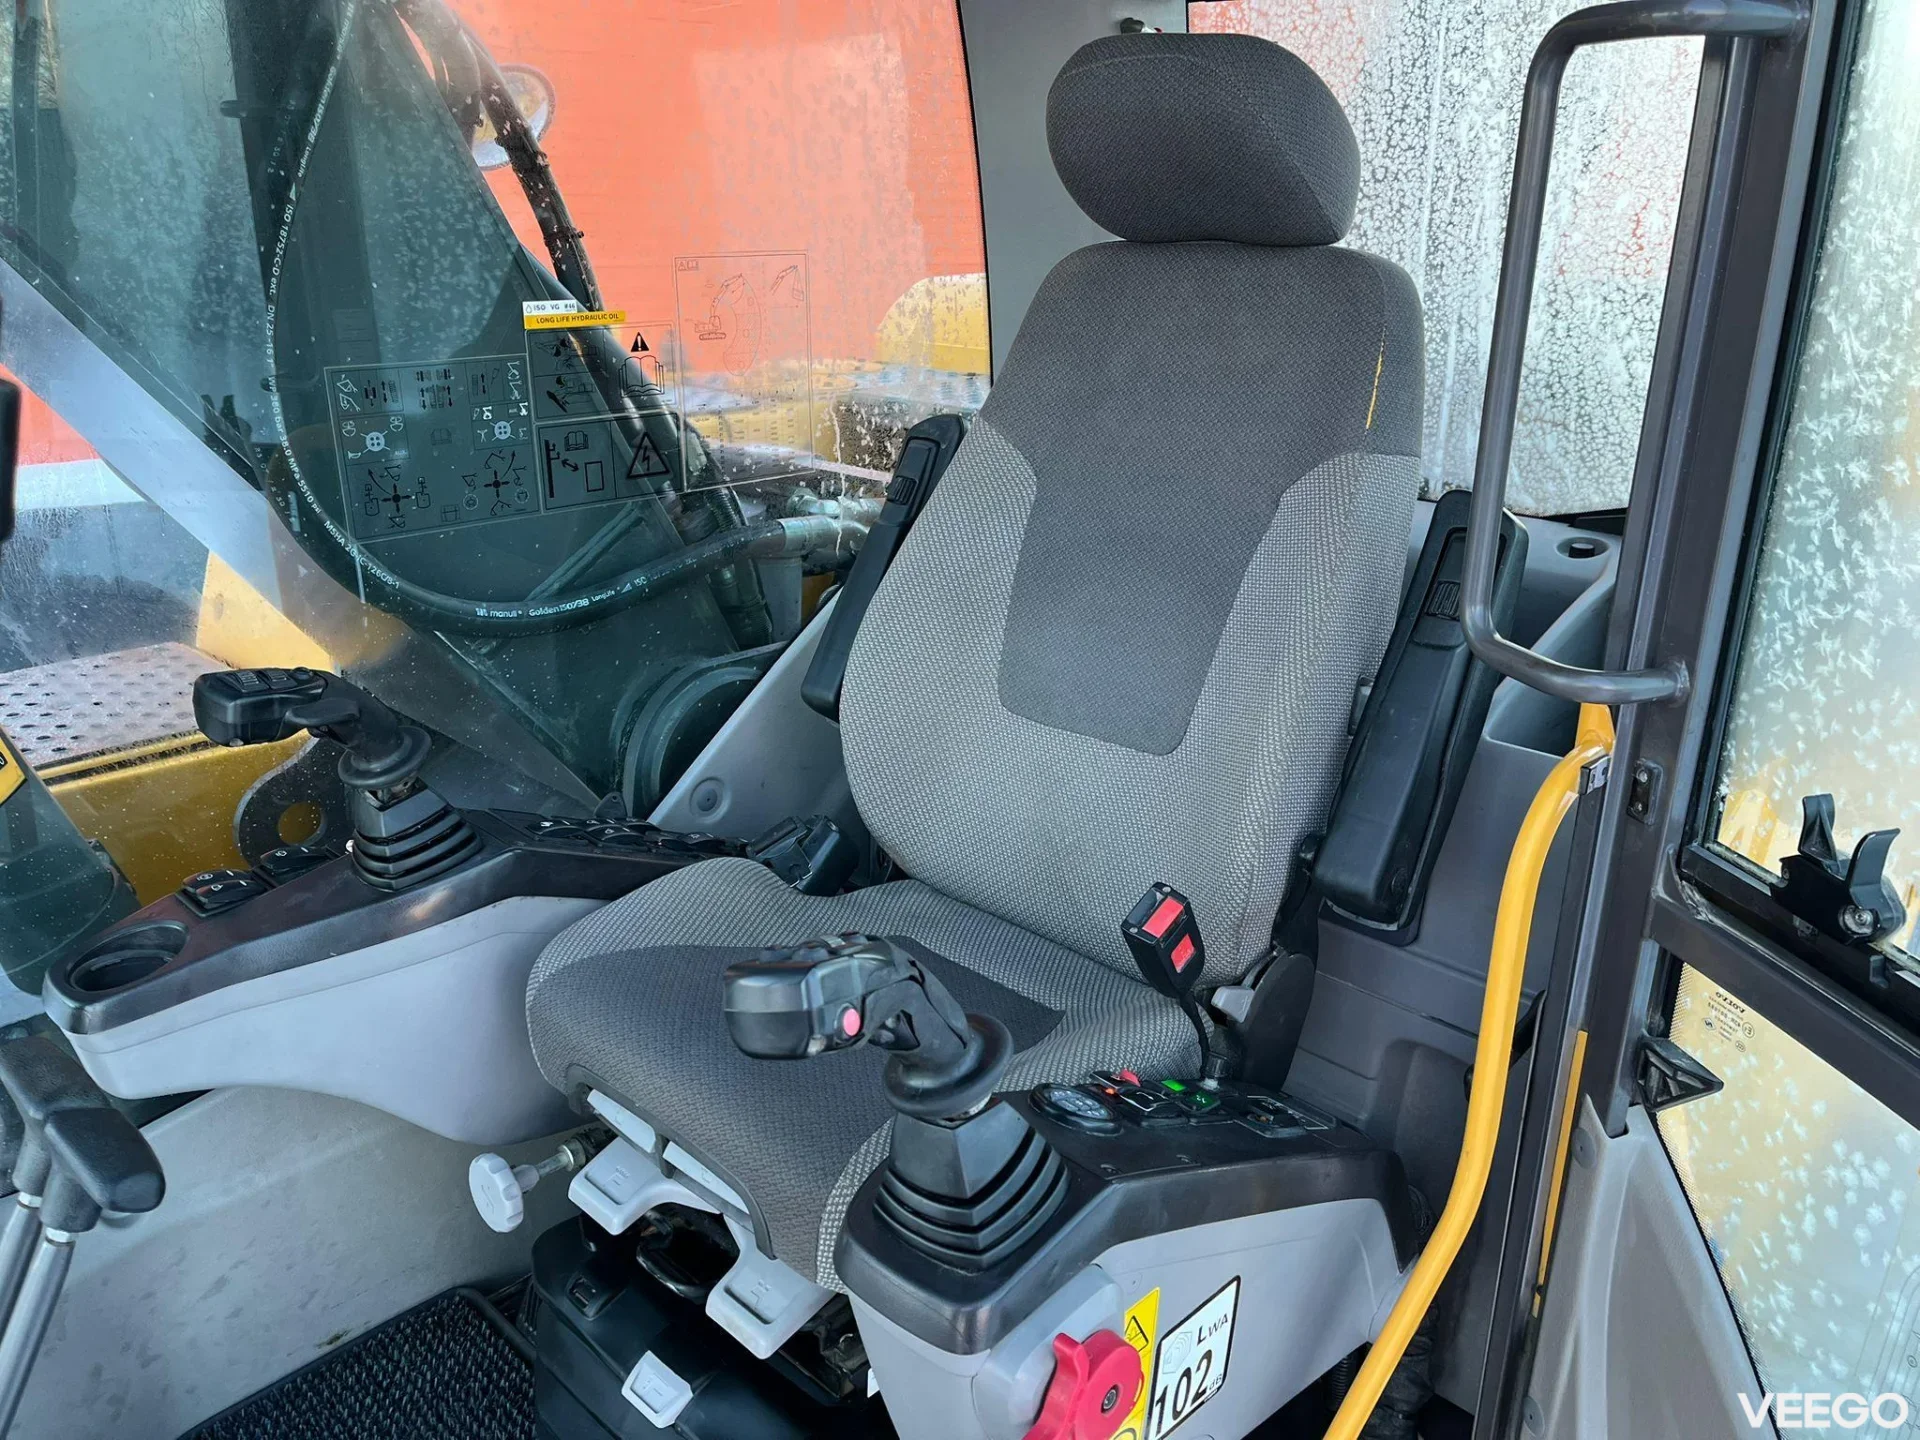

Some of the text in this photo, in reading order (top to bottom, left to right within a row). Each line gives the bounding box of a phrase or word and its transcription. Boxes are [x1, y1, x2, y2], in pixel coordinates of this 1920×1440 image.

[284, 204, 294, 222] ISO
[272, 225, 288, 275] 18752-C-D
[267, 304, 275, 321] DN
[536, 317, 555, 325] LONG
[571, 313, 607, 322] HYDRAULIC
[608, 312, 619, 320] OIL
[266, 322, 274, 336] 25
[268, 376, 277, 393] WP
[274, 416, 284, 433] bar
[280, 434, 292, 456] 38.0
[288, 457, 301, 480] MPa
[298, 480, 314, 503] 5510
[311, 502, 322, 514] psi
[324, 520, 345, 546] MSHA
[1155, 1349, 1212, 1438] 102
